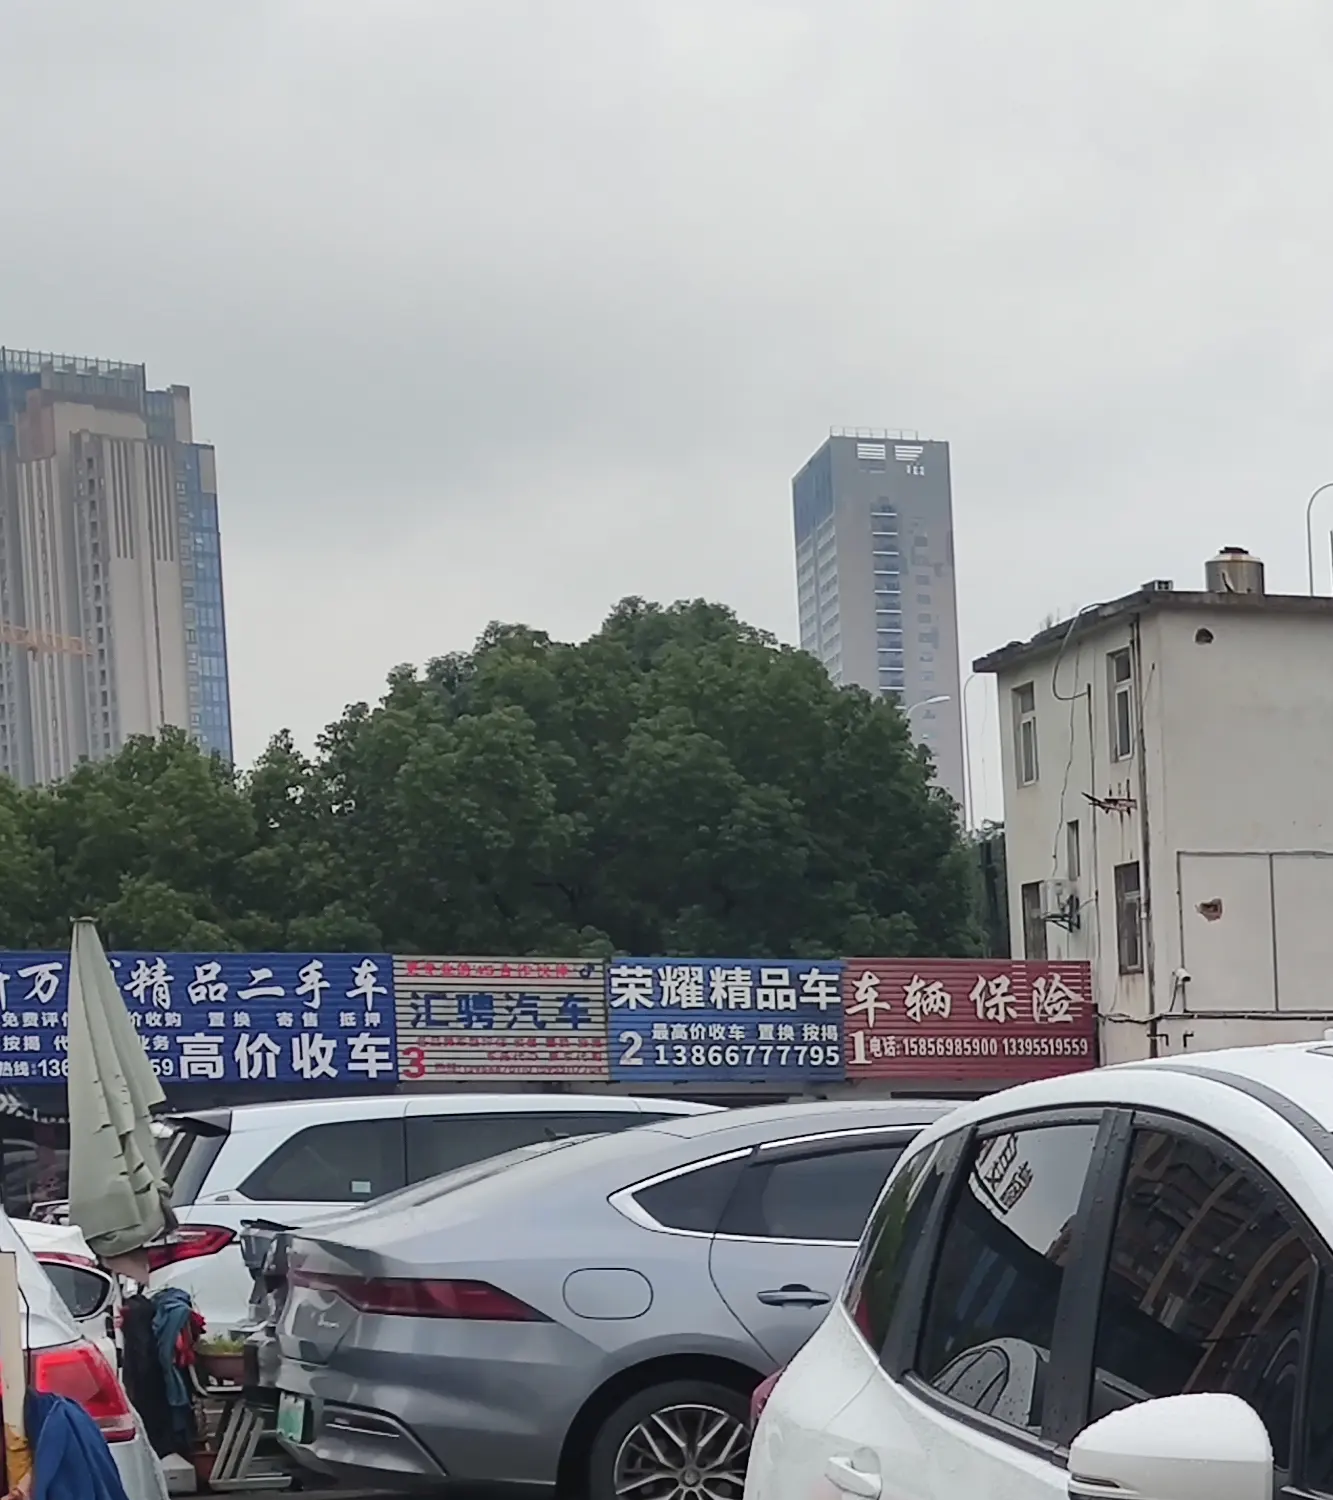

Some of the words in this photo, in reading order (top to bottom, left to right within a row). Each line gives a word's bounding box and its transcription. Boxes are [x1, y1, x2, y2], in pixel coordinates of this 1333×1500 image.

[0, 956, 390, 1011] 万精品二手车
[609, 964, 841, 1012] 荣耀精品车
[846, 972, 1084, 1028] 车辆保险
[208, 1011, 252, 1028] 置换
[276, 1011, 319, 1028] 寄售
[340, 1011, 380, 1028] 抵押
[652, 1023, 745, 1041] 最高价收车
[758, 1024, 795, 1041] 置换
[802, 1024, 839, 1042] 按揭
[2, 1035, 41, 1051] 按揭
[177, 1032, 393, 1079] 高价收车
[619, 1031, 644, 1066] 2
[655, 1045, 840, 1067] 13866777795
[848, 1031, 873, 1064] 1
[1002, 1038, 1089, 1057] 13395519559
[402, 1046, 426, 1079] 3
